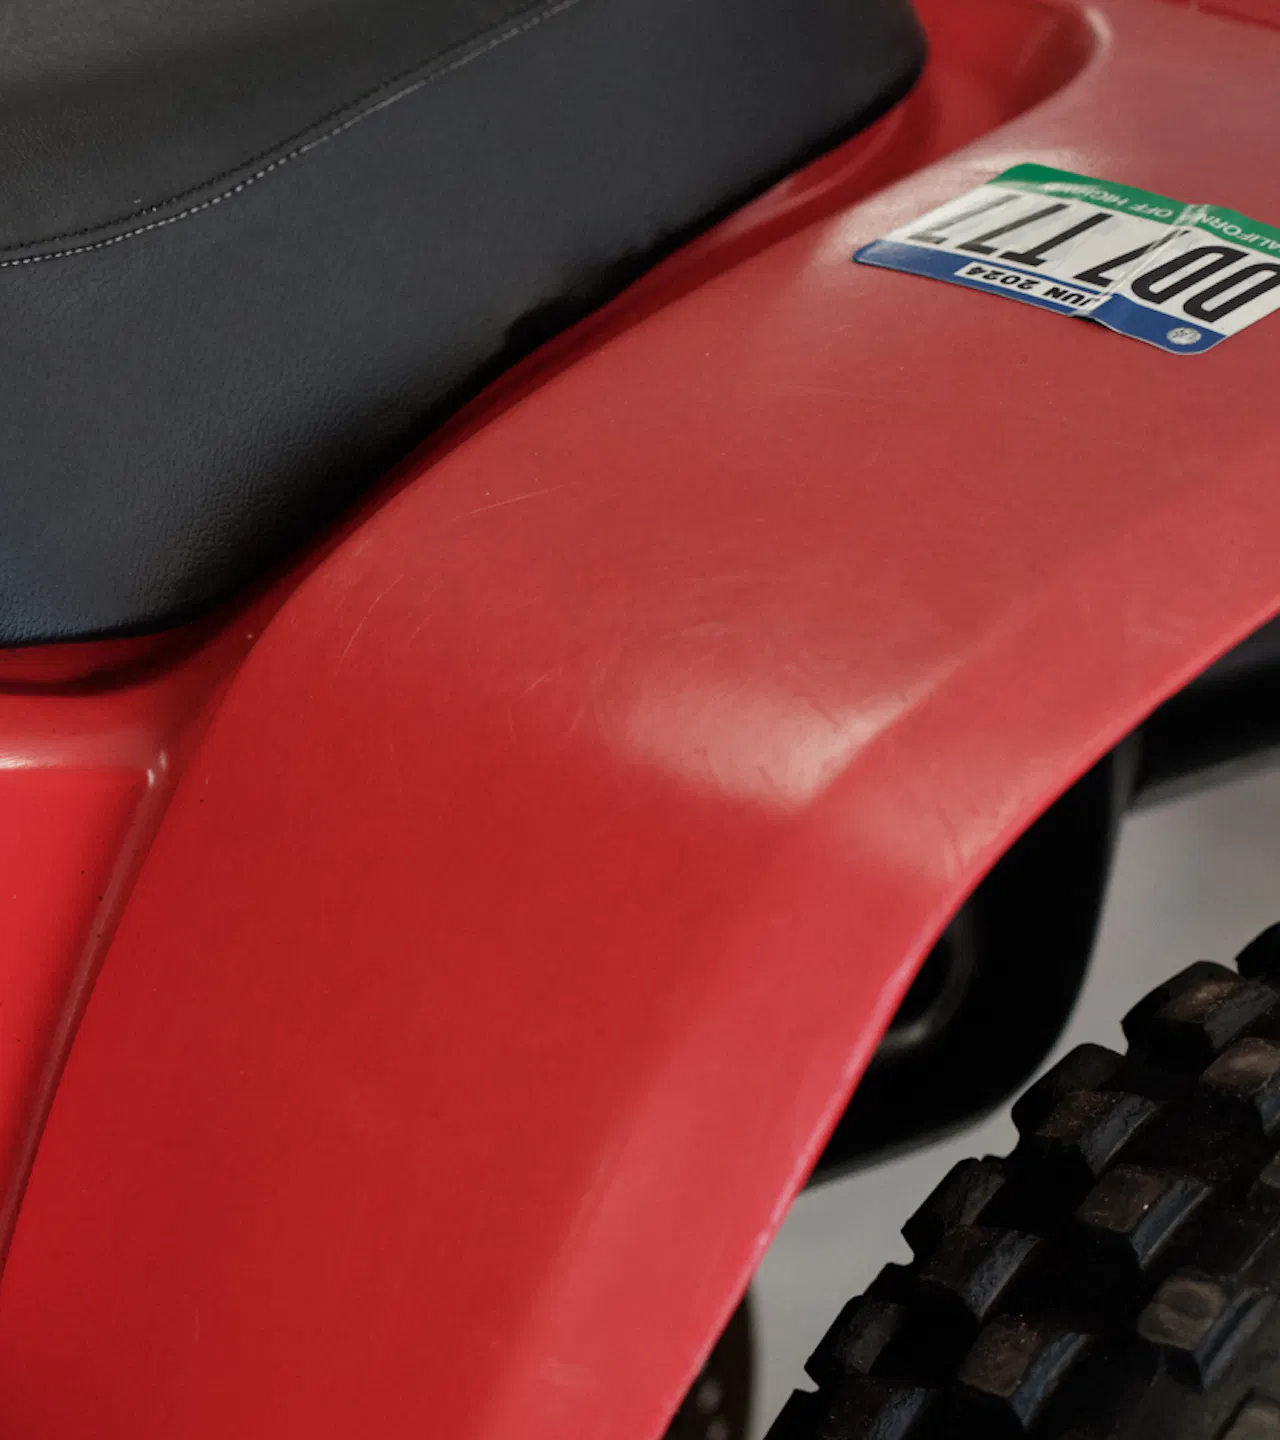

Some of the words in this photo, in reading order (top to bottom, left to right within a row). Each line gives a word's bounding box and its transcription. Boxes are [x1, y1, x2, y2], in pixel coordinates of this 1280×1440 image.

[1129, 203, 1174, 218] OFF
[965, 266, 1039, 290] 2024
[1043, 286, 1100, 308] JUN
